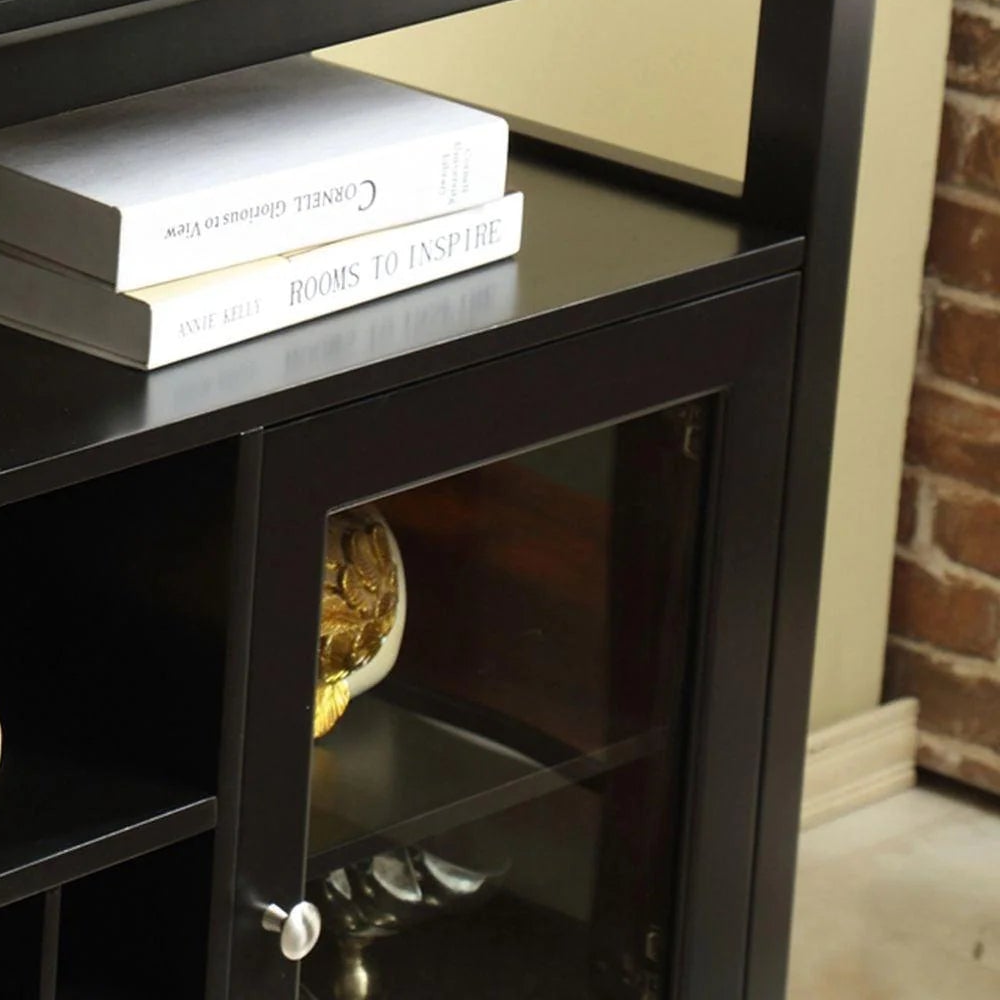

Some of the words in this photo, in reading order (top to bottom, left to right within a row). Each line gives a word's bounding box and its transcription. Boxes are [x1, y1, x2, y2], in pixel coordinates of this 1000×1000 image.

[204, 214, 221, 230] to
[223, 200, 287, 224] Glorious
[164, 222, 201, 239] View
[289, 262, 360, 307] ROOMS
[372, 250, 399, 280] TO
[409, 218, 503, 270] INSPIRE
